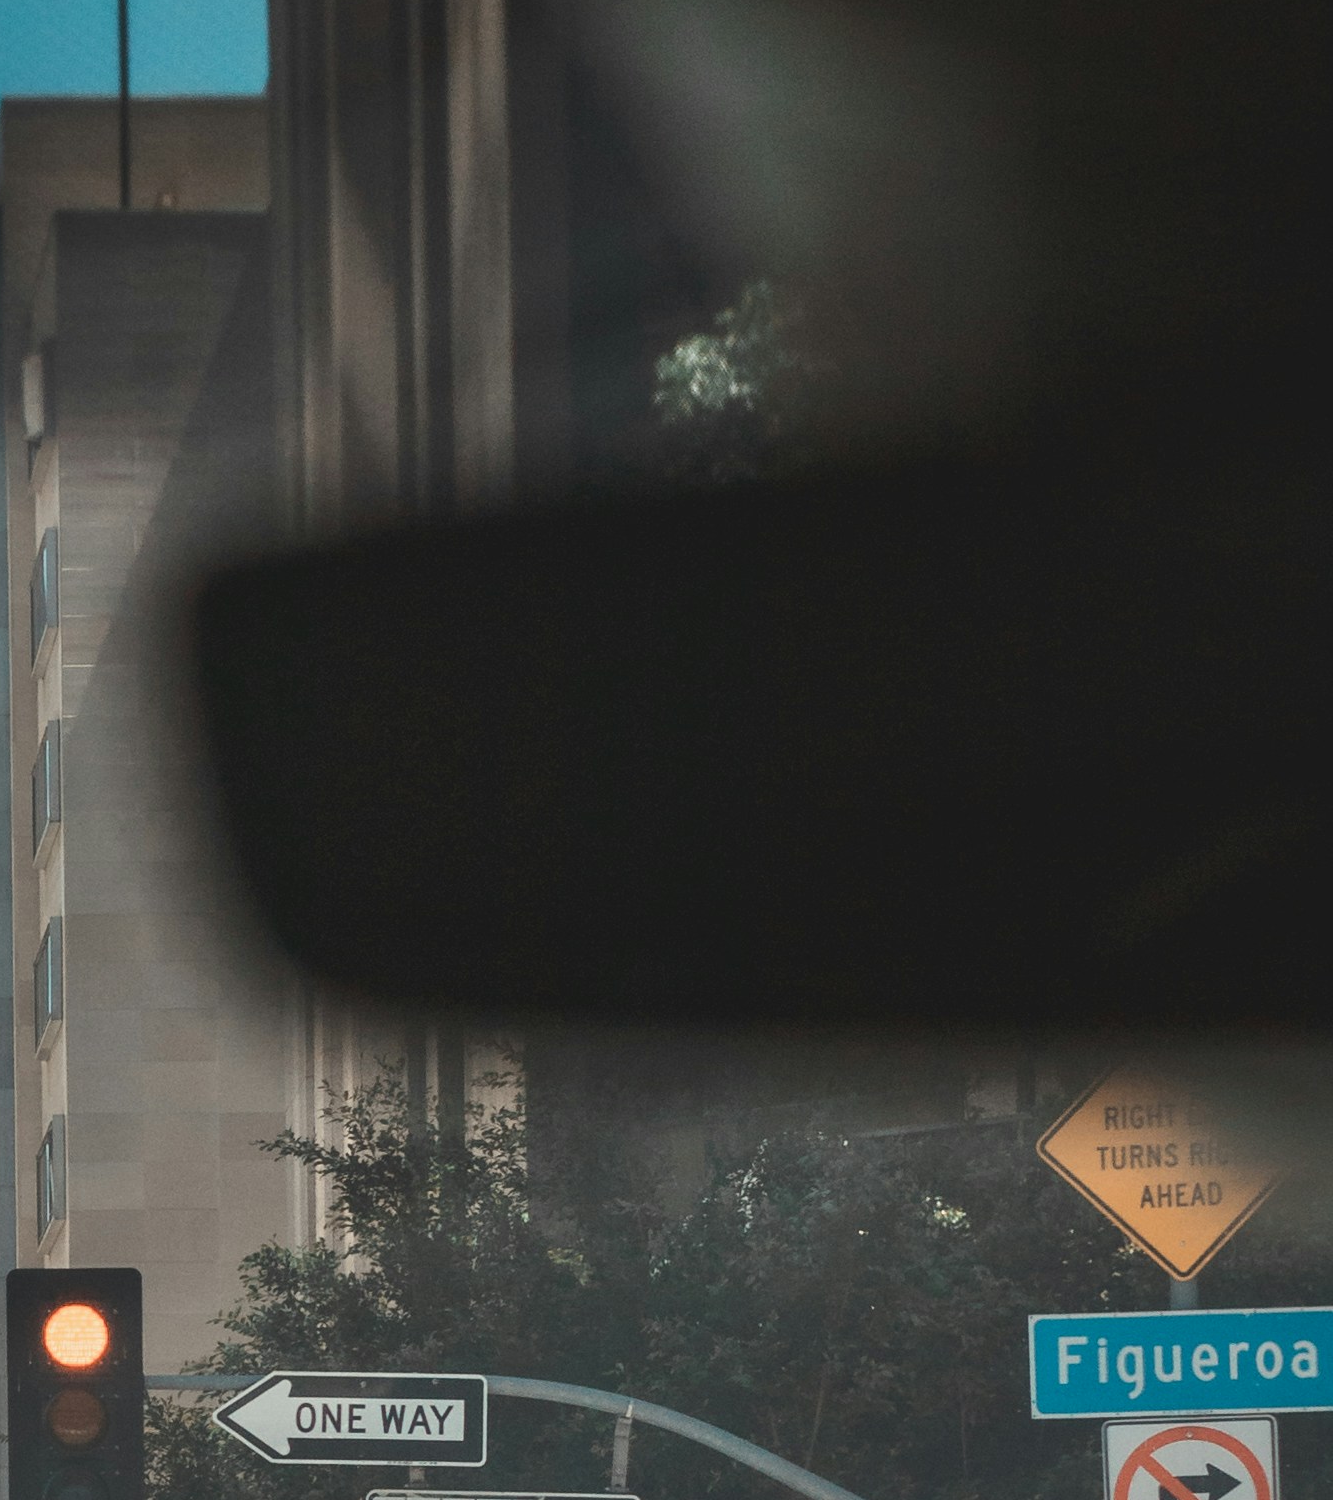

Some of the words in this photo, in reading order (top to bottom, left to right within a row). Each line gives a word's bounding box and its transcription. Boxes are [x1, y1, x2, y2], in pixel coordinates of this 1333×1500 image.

[1104, 1103, 1177, 1130] RIGHT
[1096, 1143, 1179, 1170] TURNS
[1140, 1182, 1223, 1208] AHEAD
[1057, 1336, 1319, 1399] Figueroa
[295, 1402, 367, 1434] ONE
[381, 1404, 454, 1435] WAY
